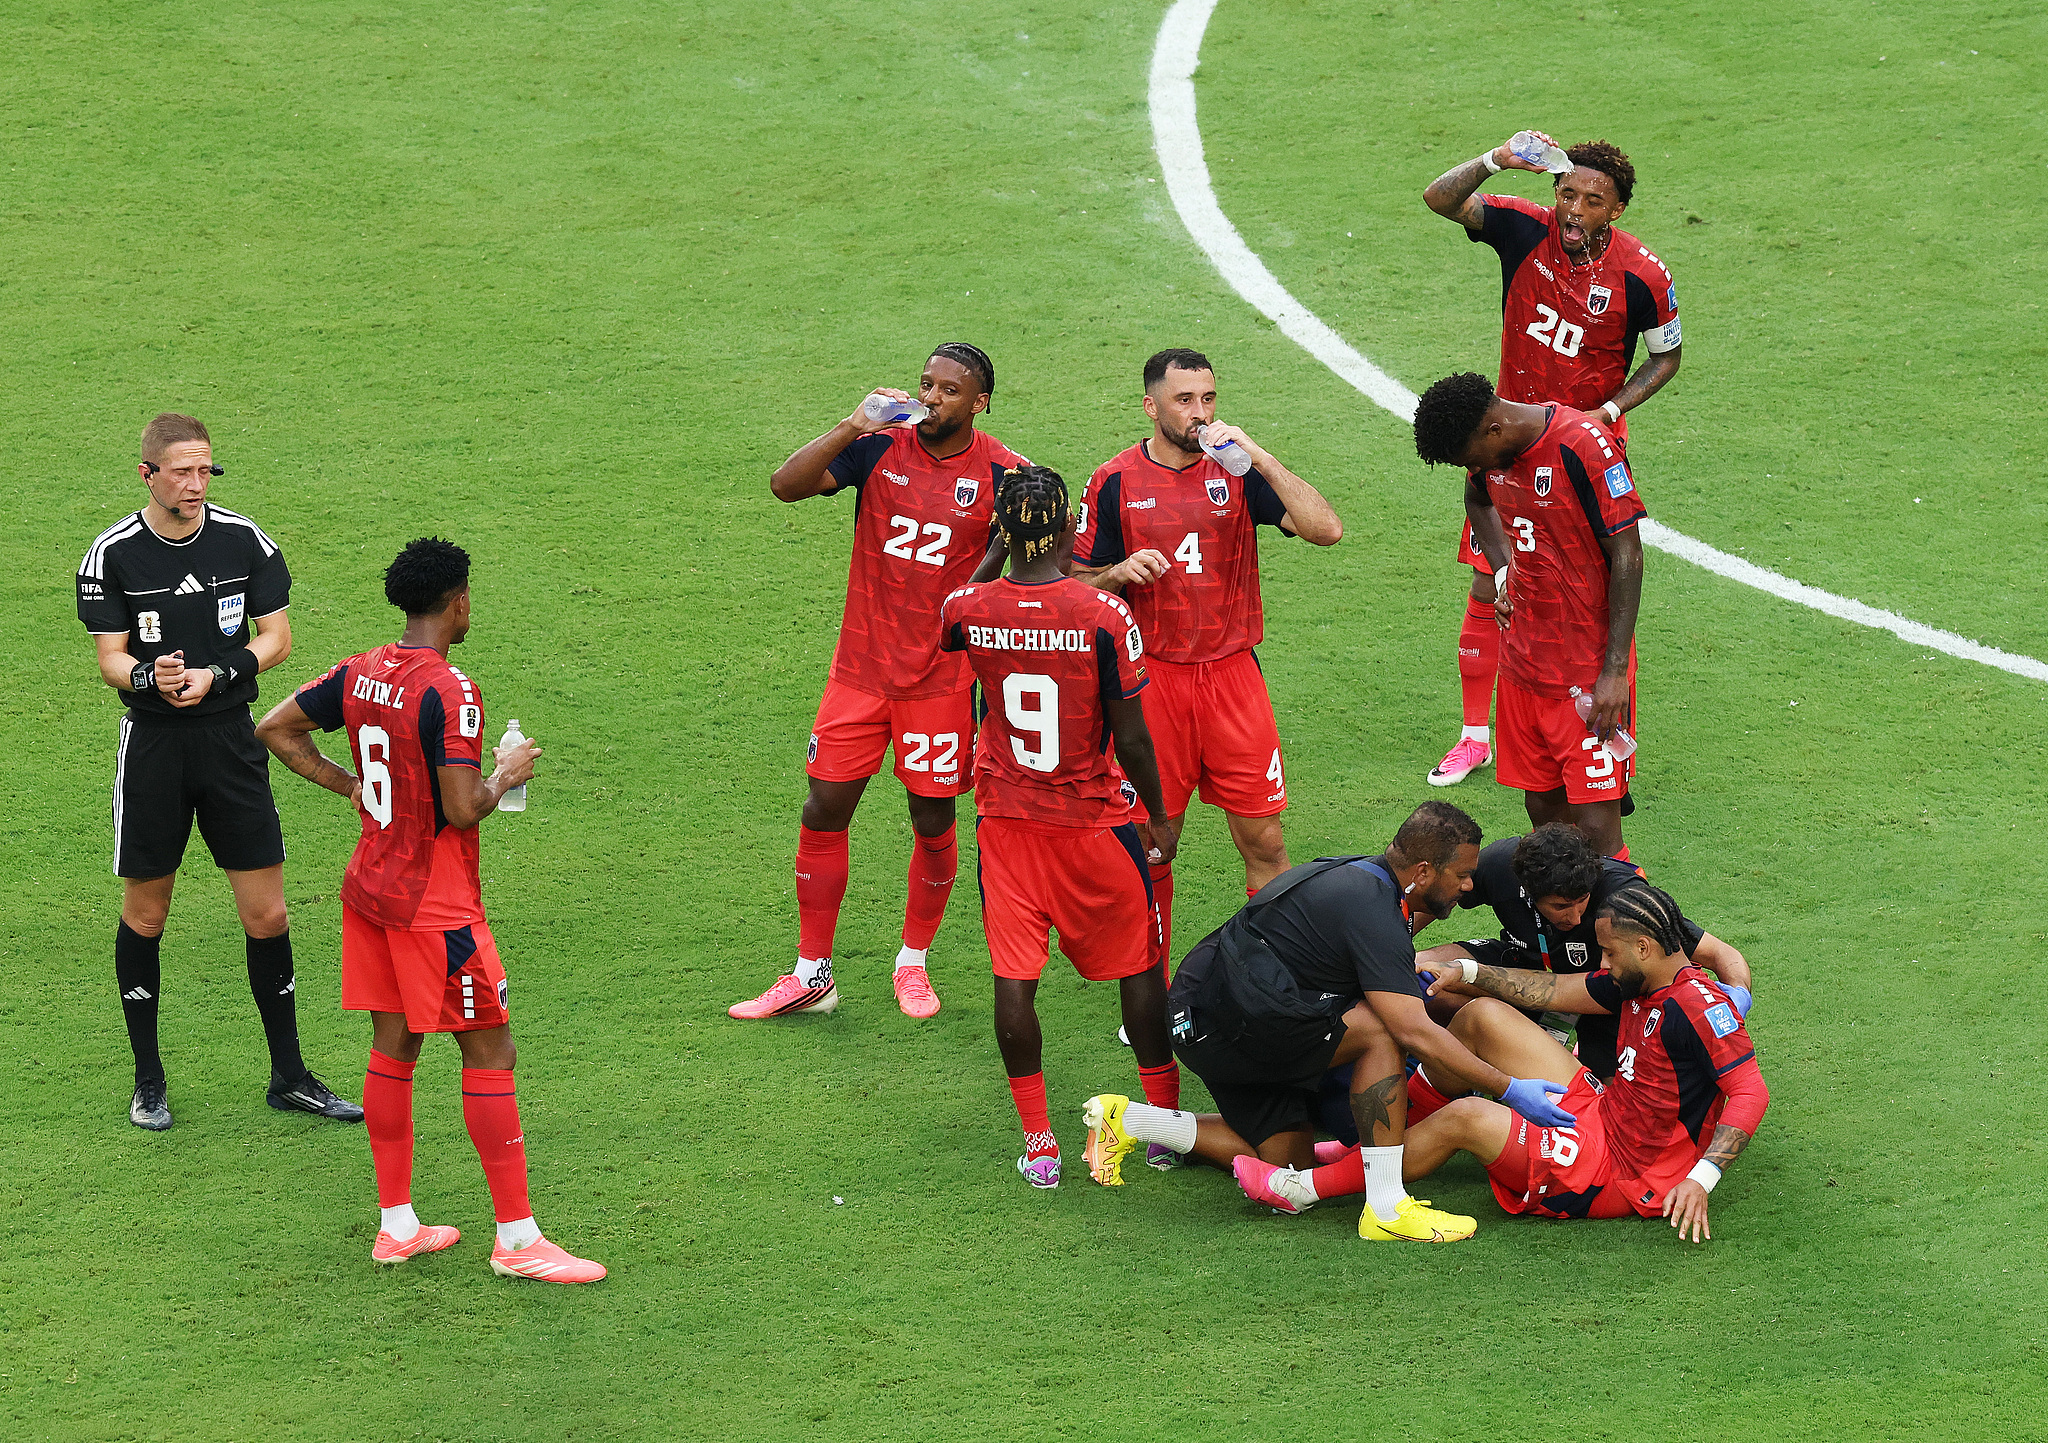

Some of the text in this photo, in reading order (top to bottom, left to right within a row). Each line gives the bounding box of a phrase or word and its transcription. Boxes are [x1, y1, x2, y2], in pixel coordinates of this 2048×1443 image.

[1526, 303, 1585, 358] 20
[882, 469, 910, 486] capelli
[1127, 498, 1156, 509] capelli
[883, 515, 952, 567] 22
[1174, 532, 1203, 574] 4
[1512, 517, 1536, 552] 3
[81, 584, 103, 593] FIFA
[222, 597, 242, 610] FIFA
[221, 612, 242, 622] REFEREE
[968, 625, 1091, 652] BENCHIMOL
[1003, 672, 1060, 773] 9
[902, 732, 959, 772] 22
[1266, 747, 1283, 789] 4
[1582, 737, 1614, 778] 3
[358, 724, 393, 830] 6
[1587, 777, 1616, 789] capelli
